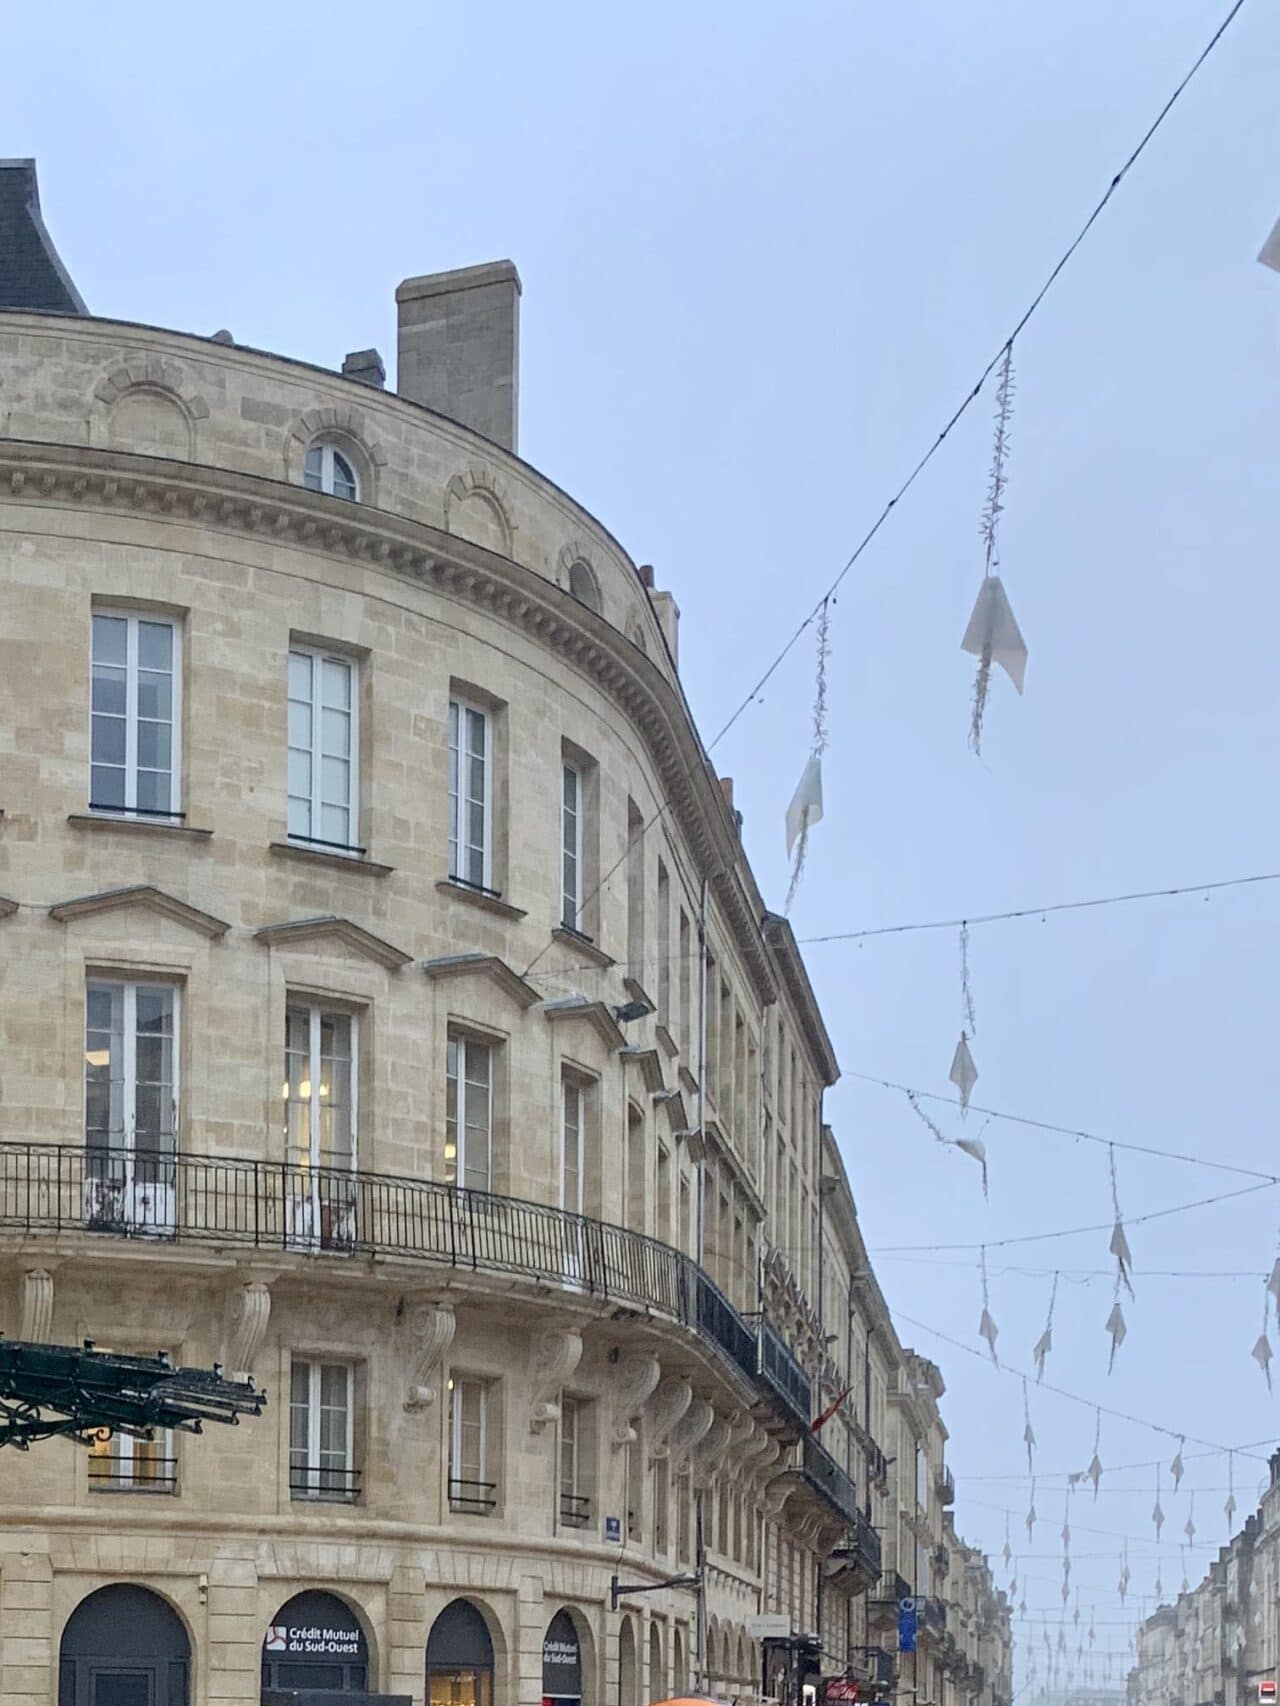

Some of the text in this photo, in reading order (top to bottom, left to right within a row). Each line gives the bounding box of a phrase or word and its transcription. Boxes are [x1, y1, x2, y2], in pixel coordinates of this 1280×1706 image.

[289, 1627, 359, 1642] Crédit Mutuel
[289, 1640, 358, 1653] du Sud-Ouest
